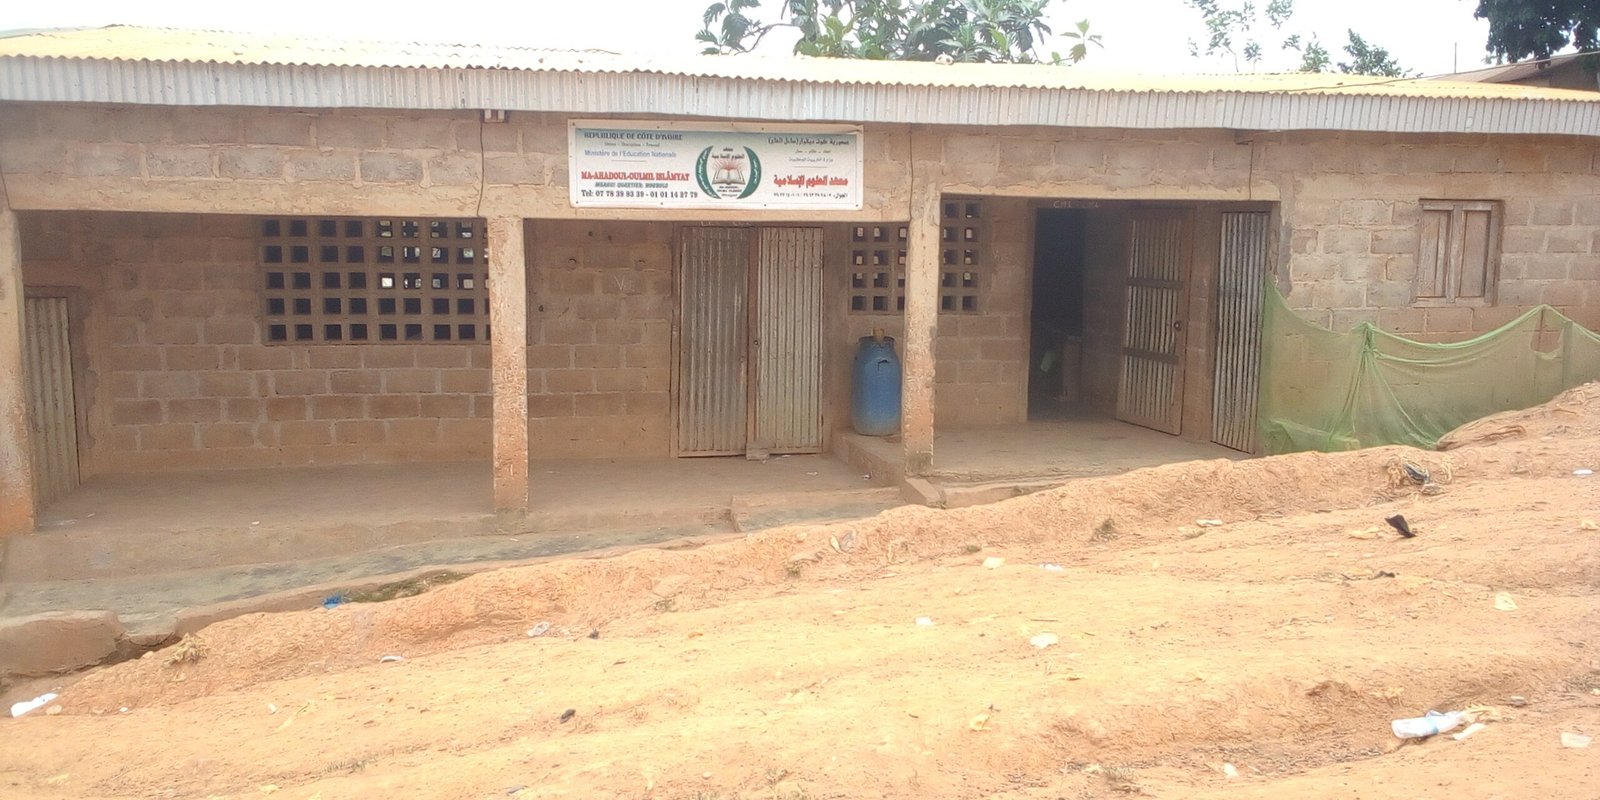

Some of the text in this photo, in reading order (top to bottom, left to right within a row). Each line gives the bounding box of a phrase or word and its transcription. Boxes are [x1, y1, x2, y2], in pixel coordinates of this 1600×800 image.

[636, 132, 654, 140] CÔTE
[651, 150, 677, 158] Nationale
[806, 175, 828, 188] العلوم
